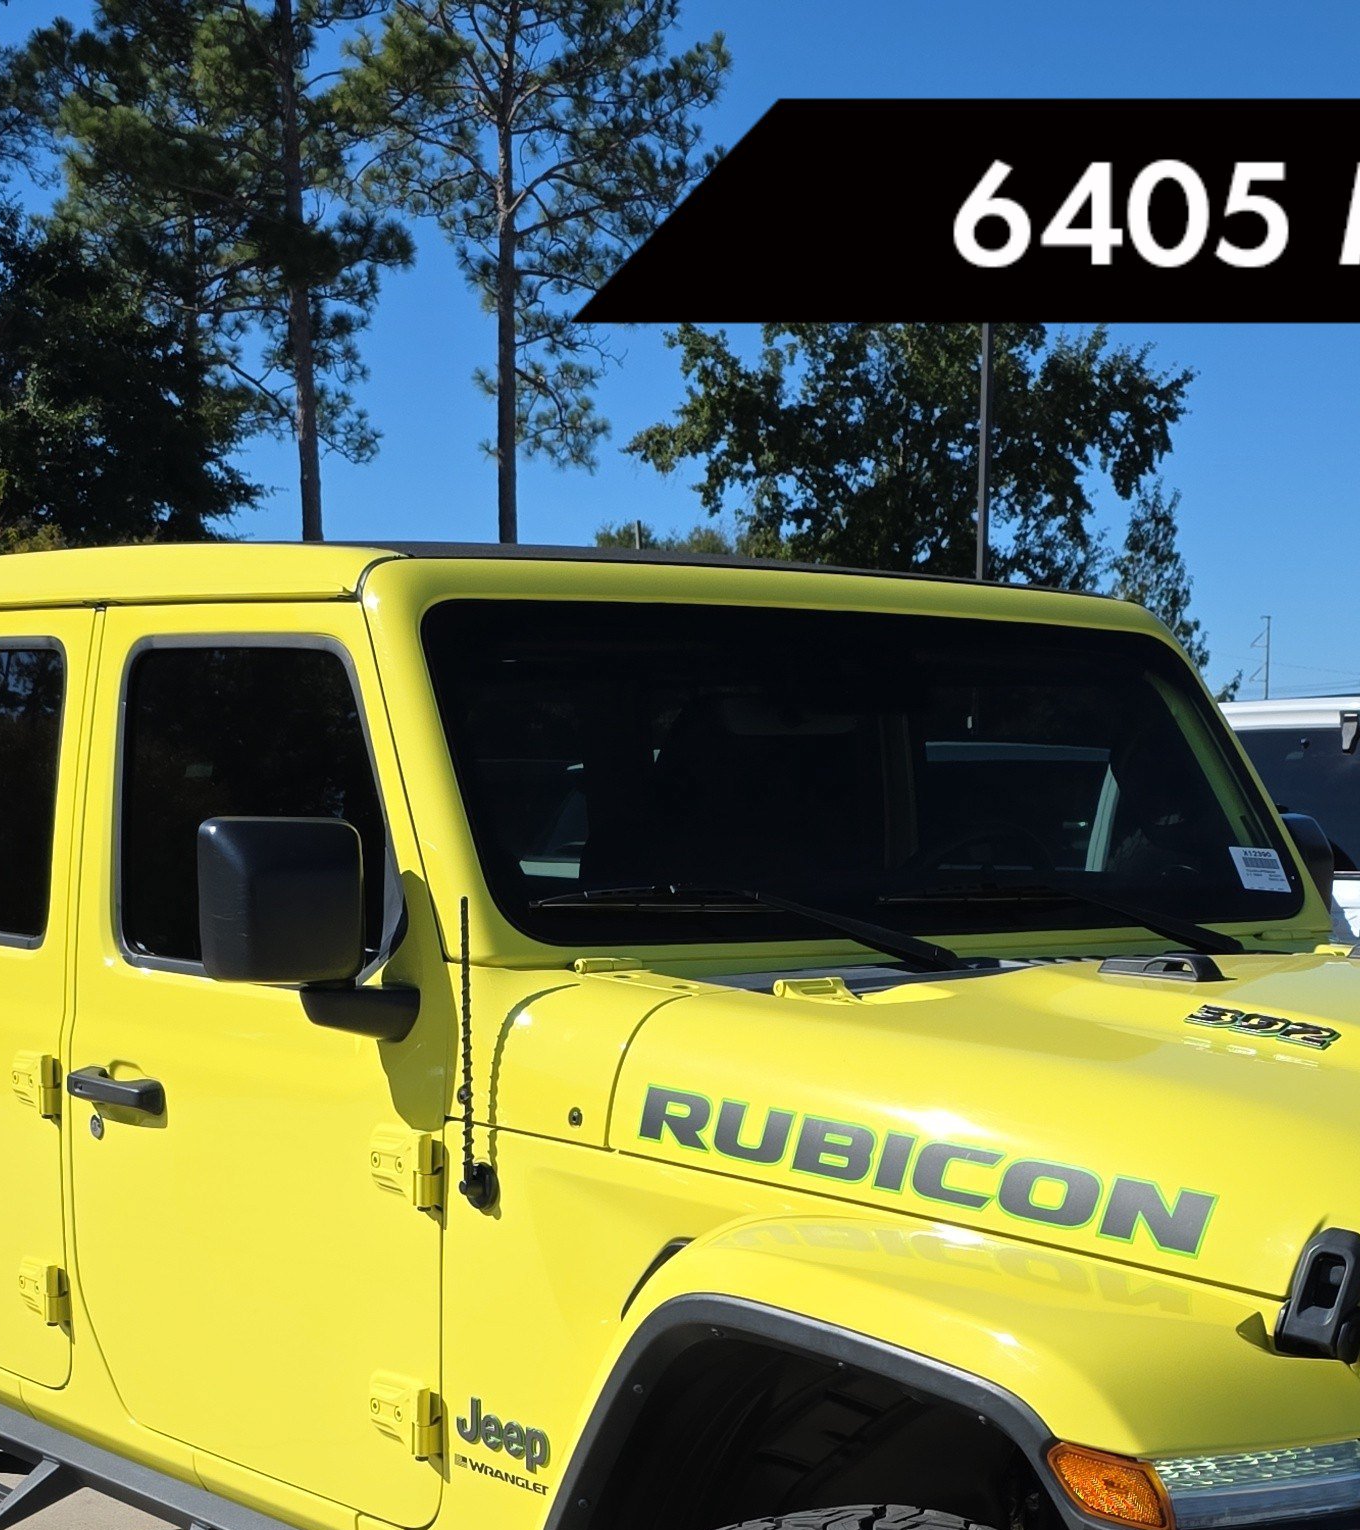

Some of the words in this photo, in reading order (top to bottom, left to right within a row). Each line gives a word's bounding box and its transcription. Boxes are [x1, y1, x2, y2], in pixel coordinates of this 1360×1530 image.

[1183, 1003, 1343, 1051] 392
[636, 1083, 1220, 1260] RUBICON
[455, 1396, 551, 1475] Jeep
